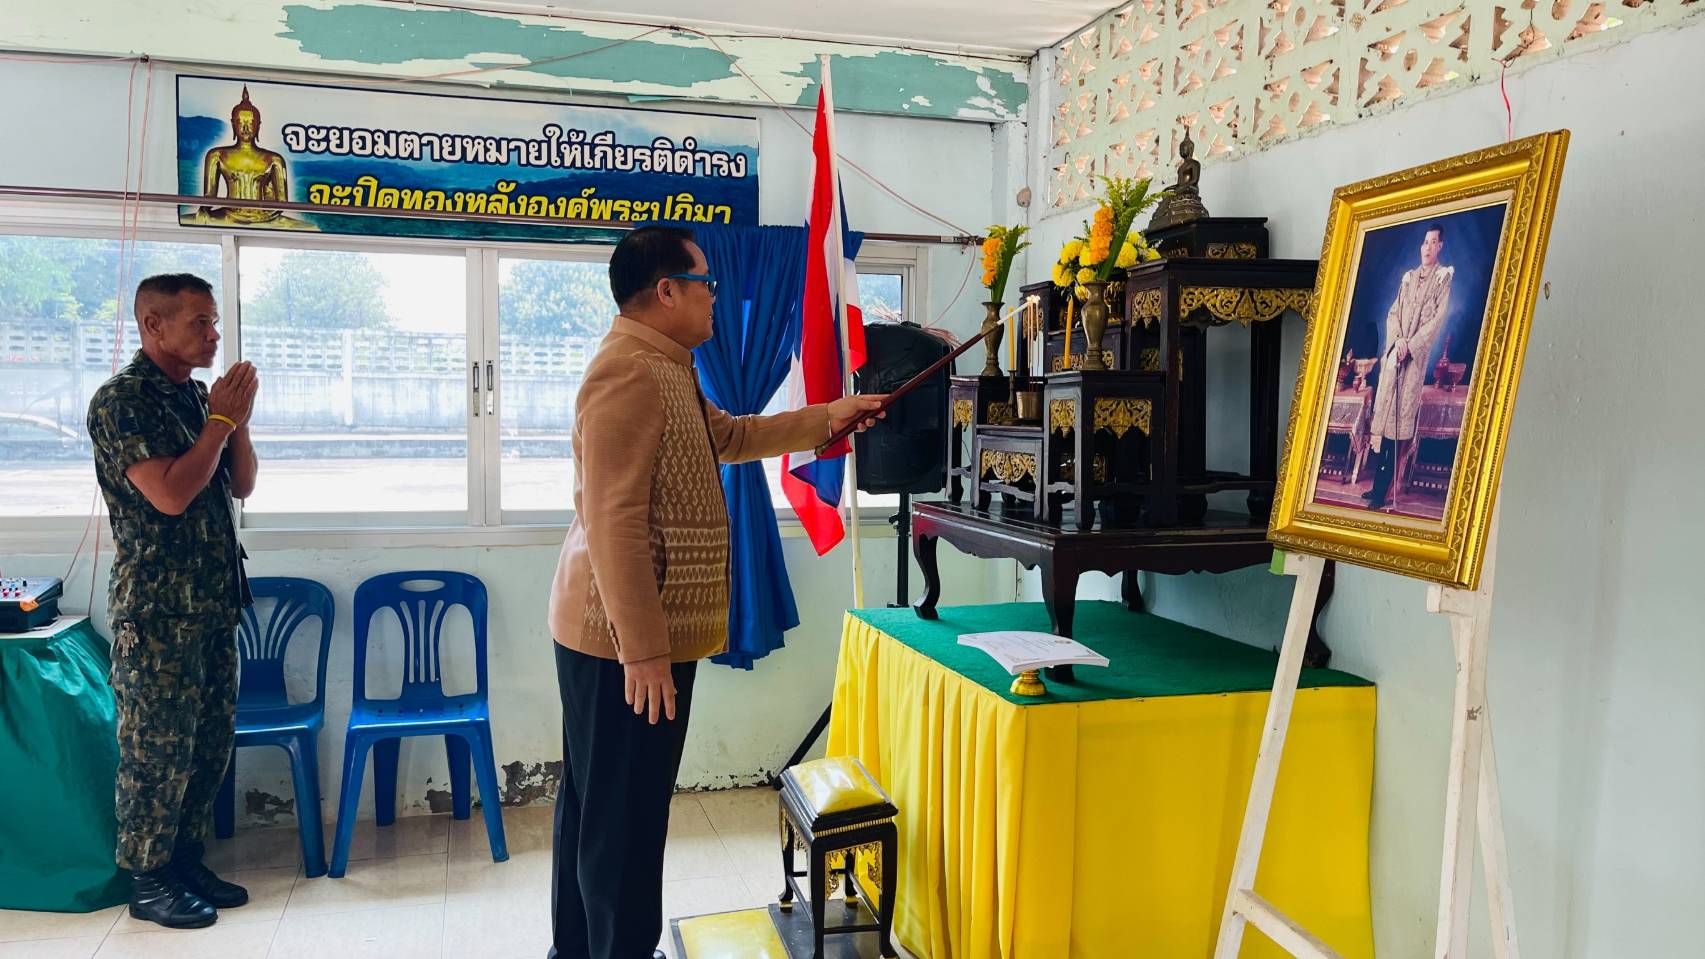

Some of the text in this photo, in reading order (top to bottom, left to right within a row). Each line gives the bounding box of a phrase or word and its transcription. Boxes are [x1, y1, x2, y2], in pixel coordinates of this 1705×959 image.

[283, 125, 748, 178] จะยอมตายหมายให้เกียรติดำรง
